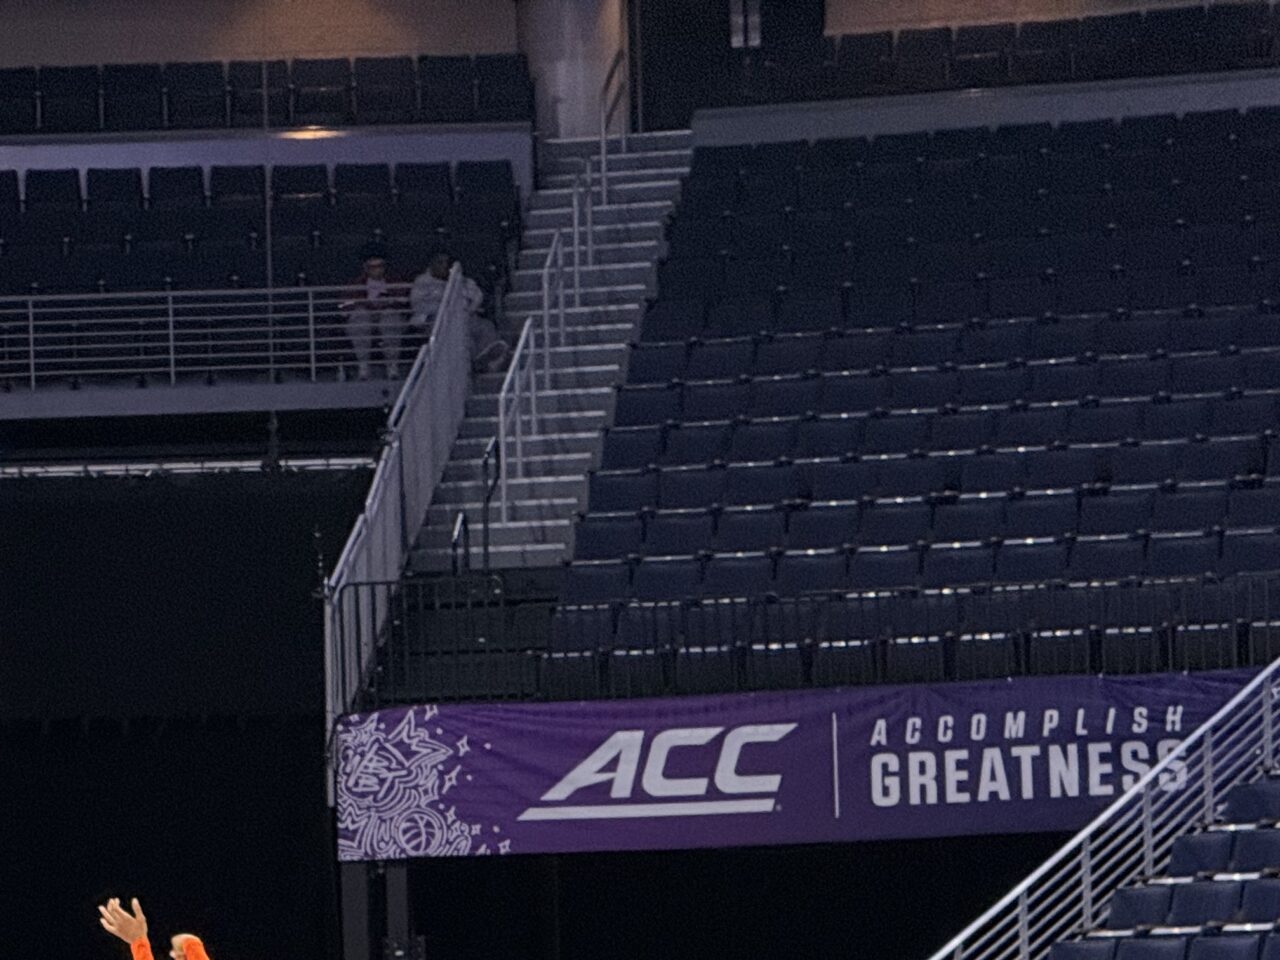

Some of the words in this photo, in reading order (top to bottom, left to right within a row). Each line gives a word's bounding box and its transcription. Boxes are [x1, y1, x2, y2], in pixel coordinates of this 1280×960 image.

[870, 705, 1184, 746] ACCOMPLISH
[540, 723, 799, 801] ACC
[871, 739, 1188, 808] GREATNESS
